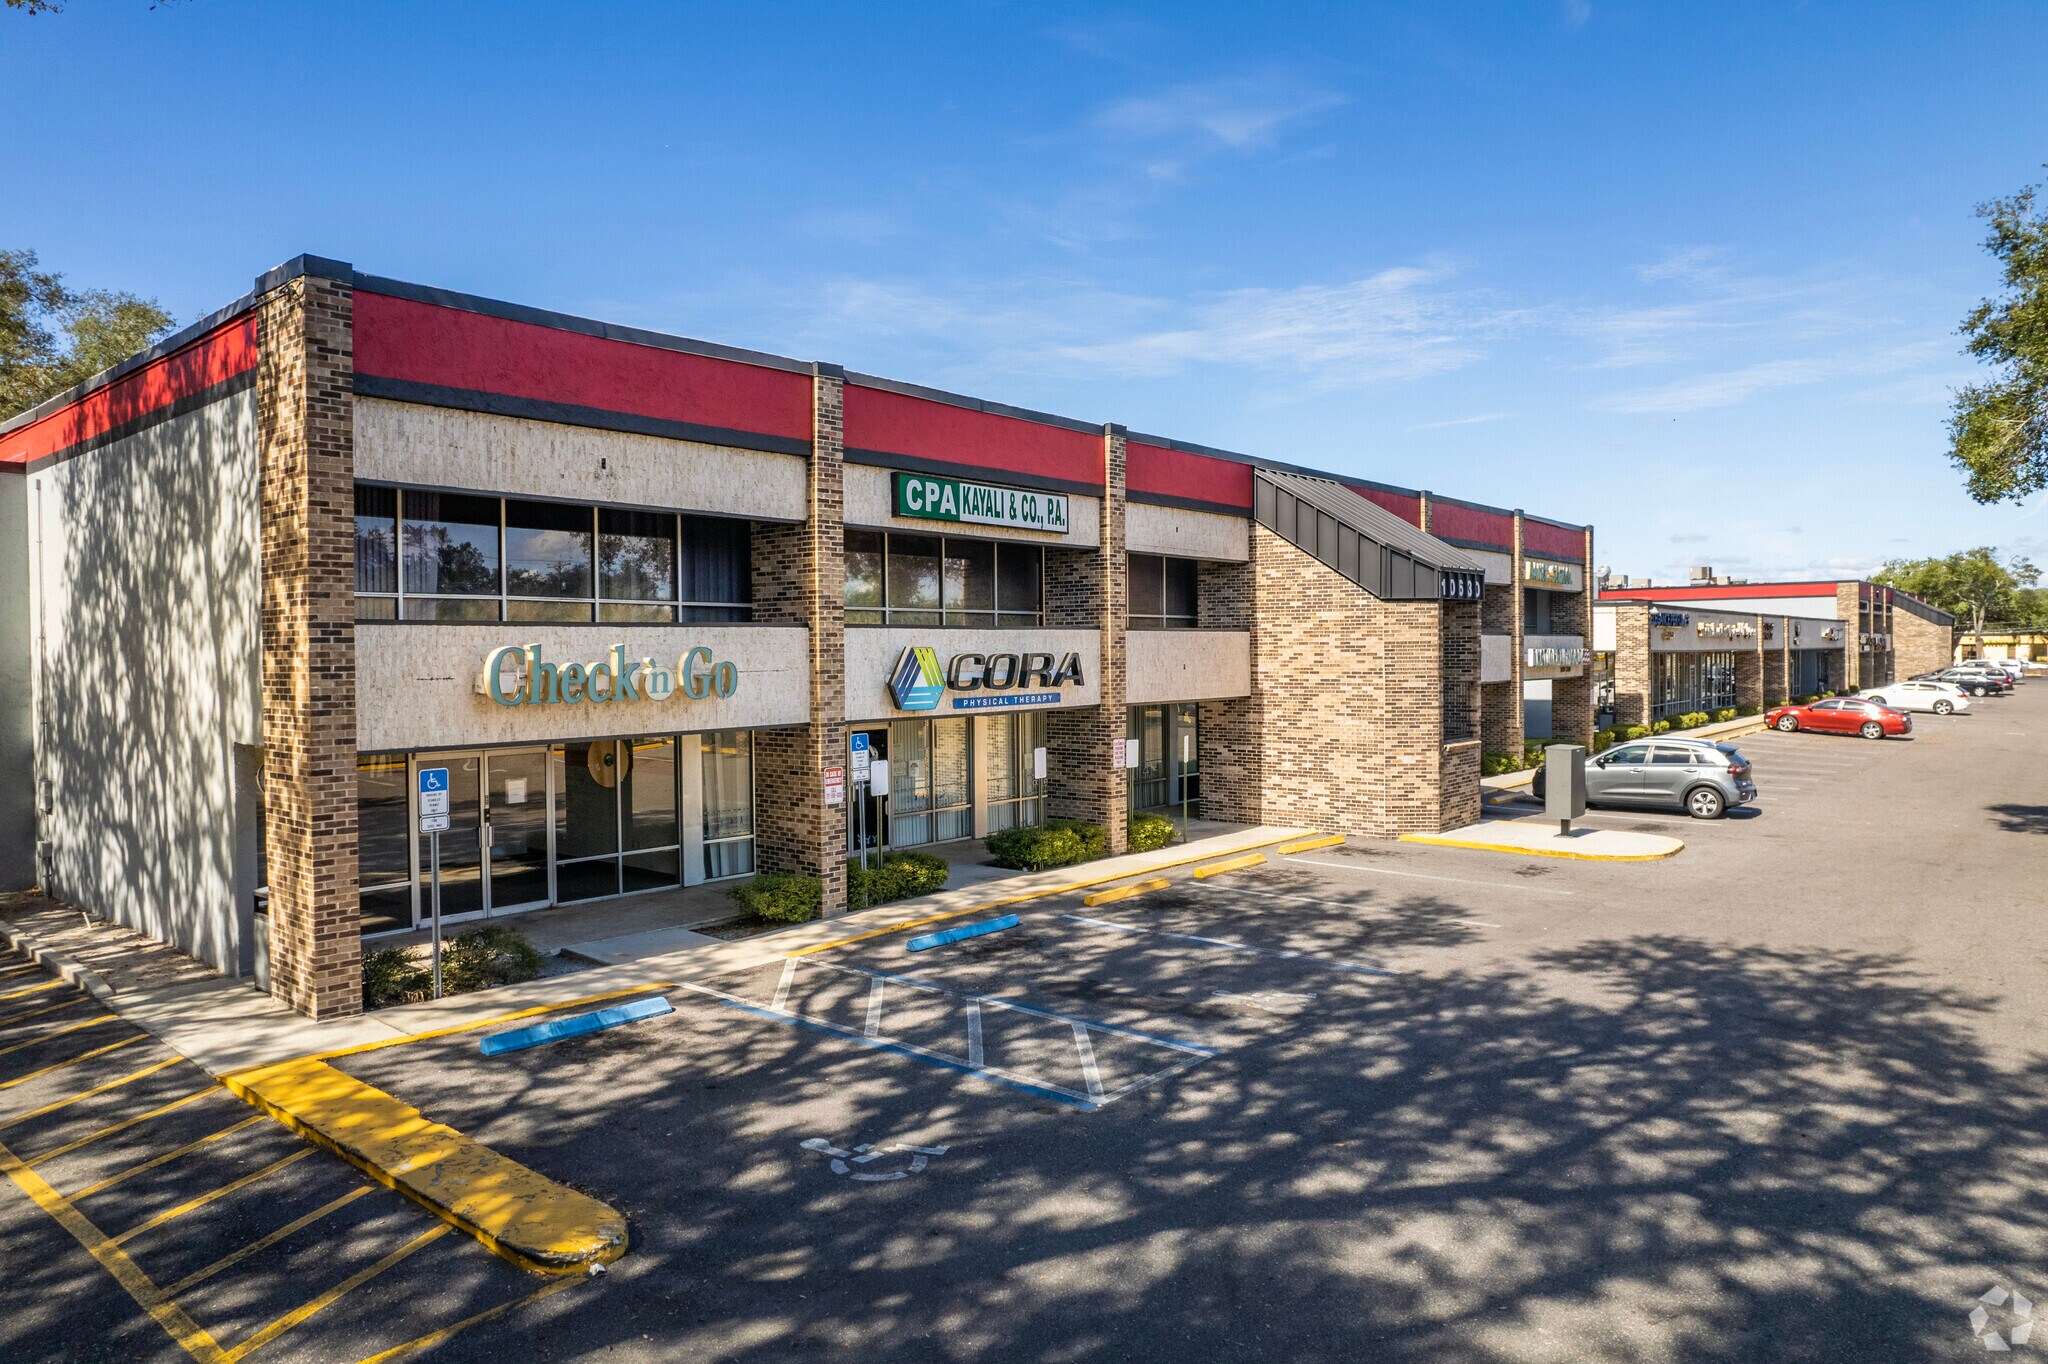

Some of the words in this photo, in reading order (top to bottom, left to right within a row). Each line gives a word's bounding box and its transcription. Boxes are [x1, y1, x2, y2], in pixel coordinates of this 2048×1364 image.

[905, 479, 957, 515] CPA
[962, 485, 1004, 519] KAYALI
[1009, 492, 1018, 521] &
[1021, 494, 1043, 529] CO.,
[1047, 498, 1065, 527] P.A.
[1441, 578, 1481, 598] 10630
[485, 643, 640, 707] Check
[678, 646, 738, 700] Go
[947, 652, 1085, 691] CORA
[963, 697, 1009, 707] PHYSICAL
[1013, 694, 1053, 703] THERAPY
